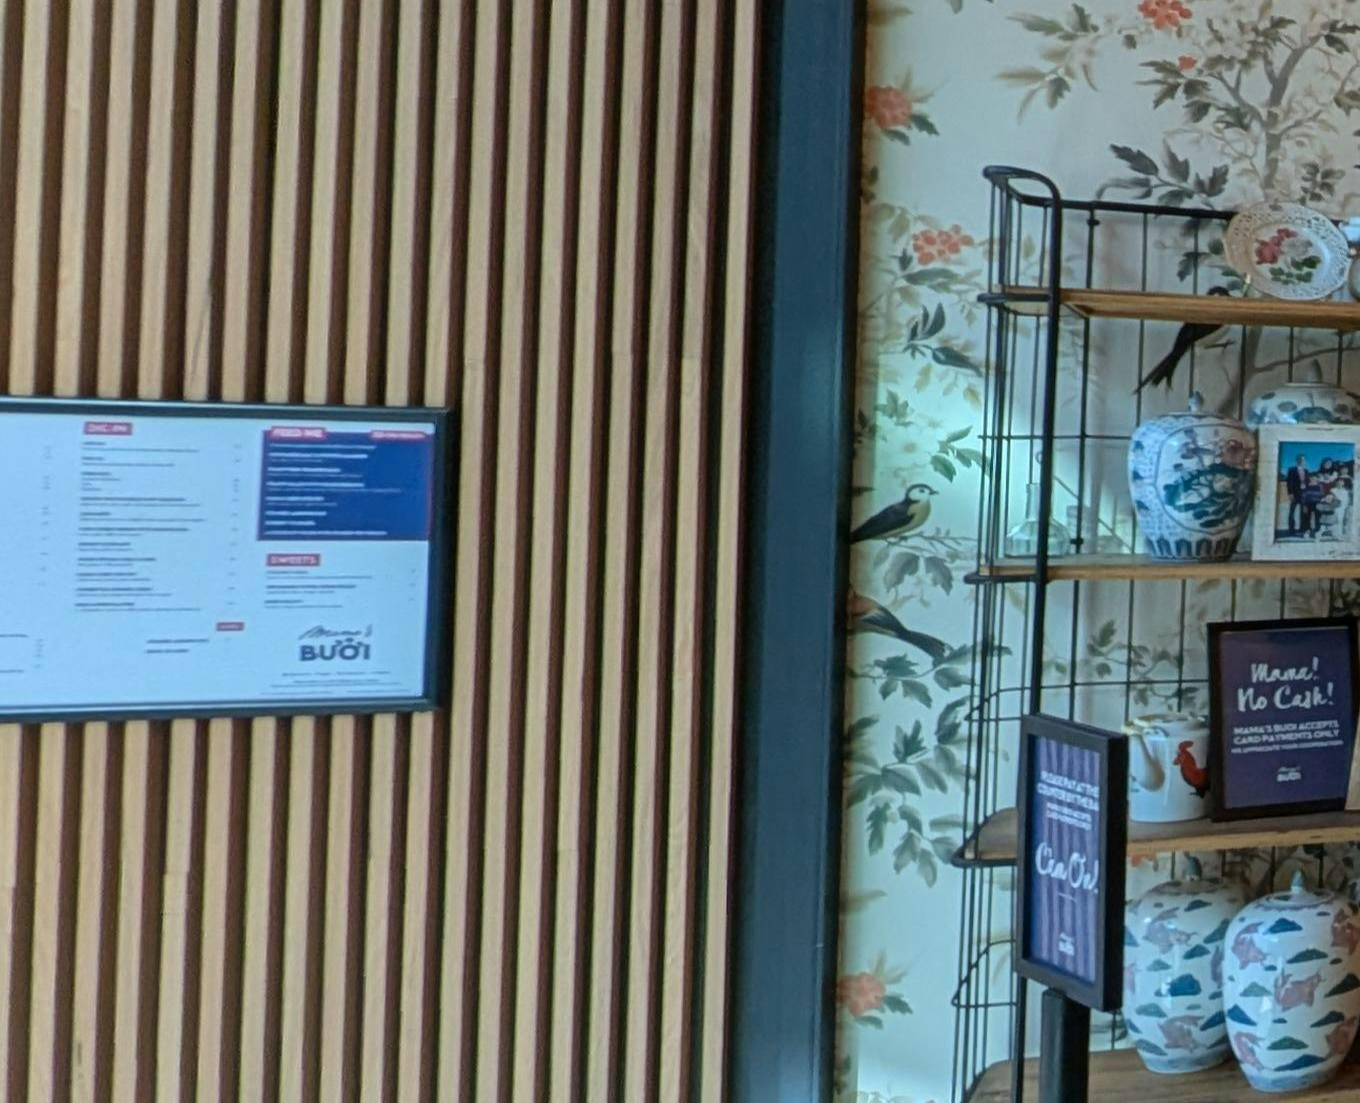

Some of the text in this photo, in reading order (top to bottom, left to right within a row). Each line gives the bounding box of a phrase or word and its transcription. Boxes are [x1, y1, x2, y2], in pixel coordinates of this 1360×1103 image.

[1250, 656, 1319, 683] Mama!
[1237, 681, 1334, 712] No Cash!
[1299, 720, 1339, 730] ACCEPTS
[1233, 729, 1340, 745] CARD PAYMENTS ONLY
